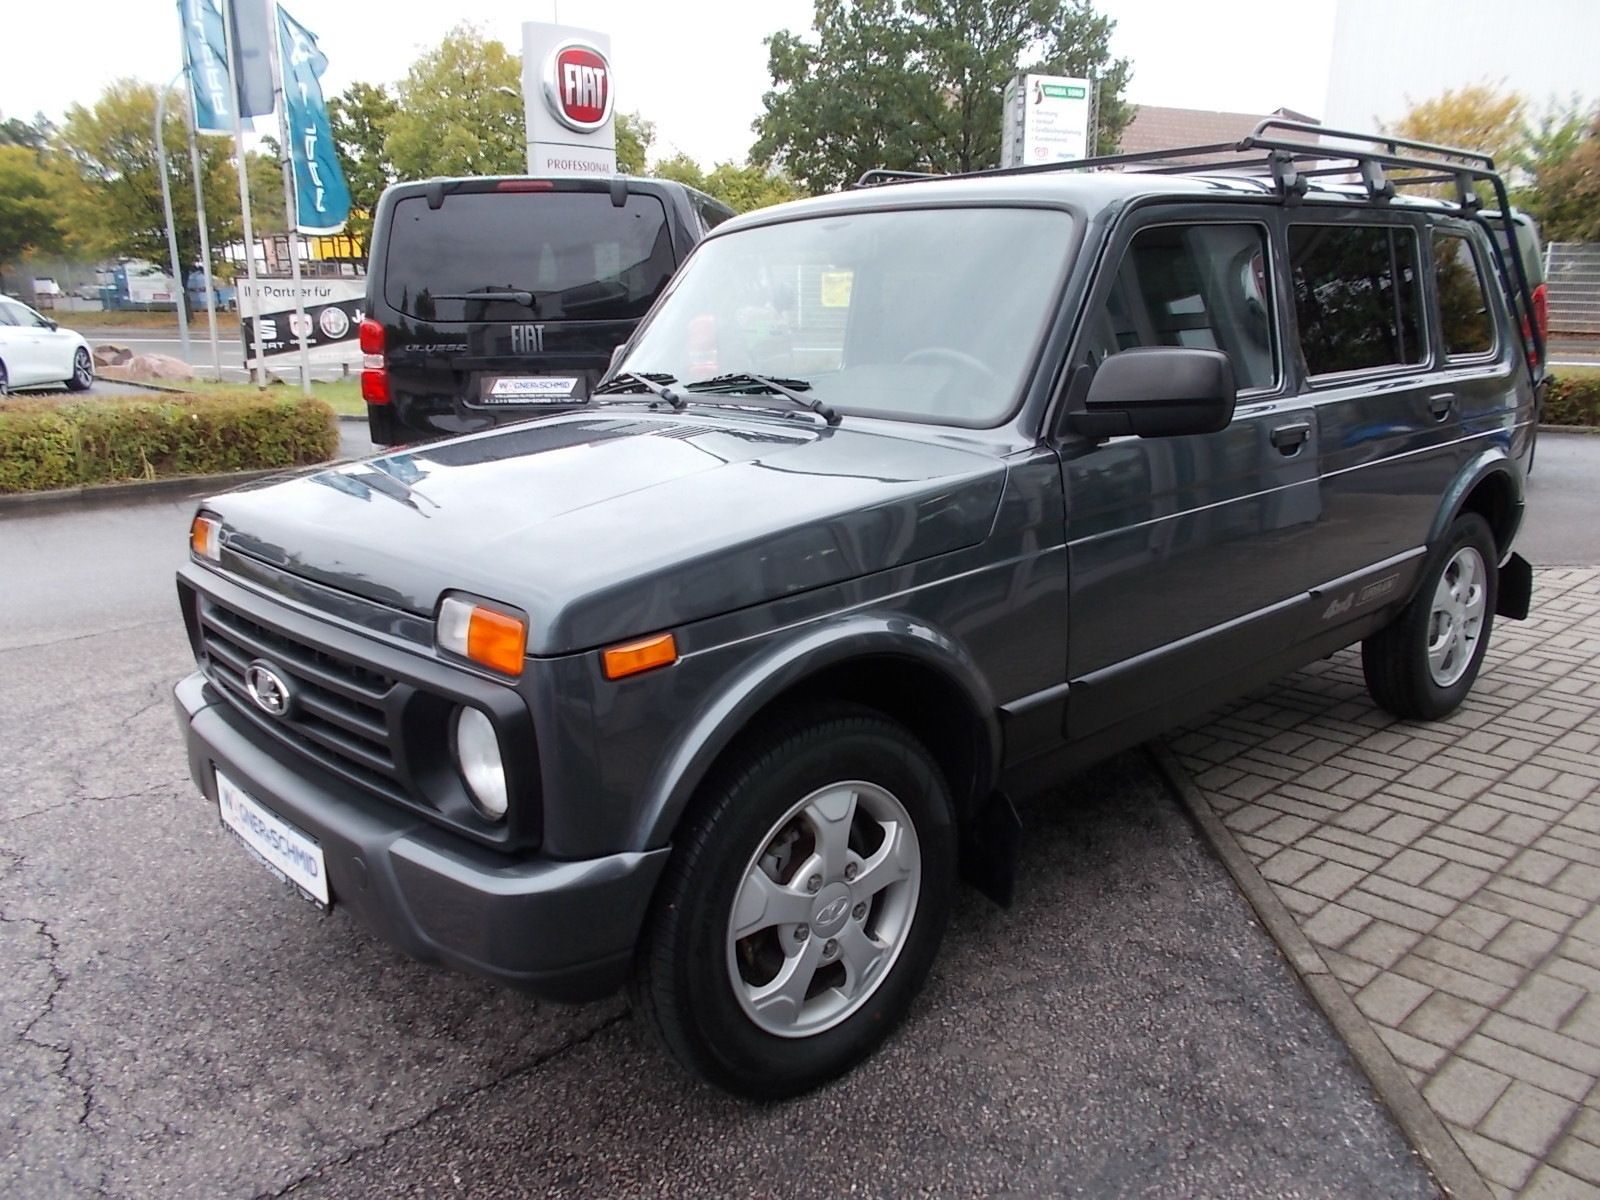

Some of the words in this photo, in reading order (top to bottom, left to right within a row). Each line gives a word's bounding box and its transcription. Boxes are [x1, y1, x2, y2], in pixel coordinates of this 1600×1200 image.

[564, 63, 605, 110] FIAT
[547, 159, 610, 174] PROFESSIONAL
[315, 285, 332, 297] für
[511, 325, 545, 352] FIAT
